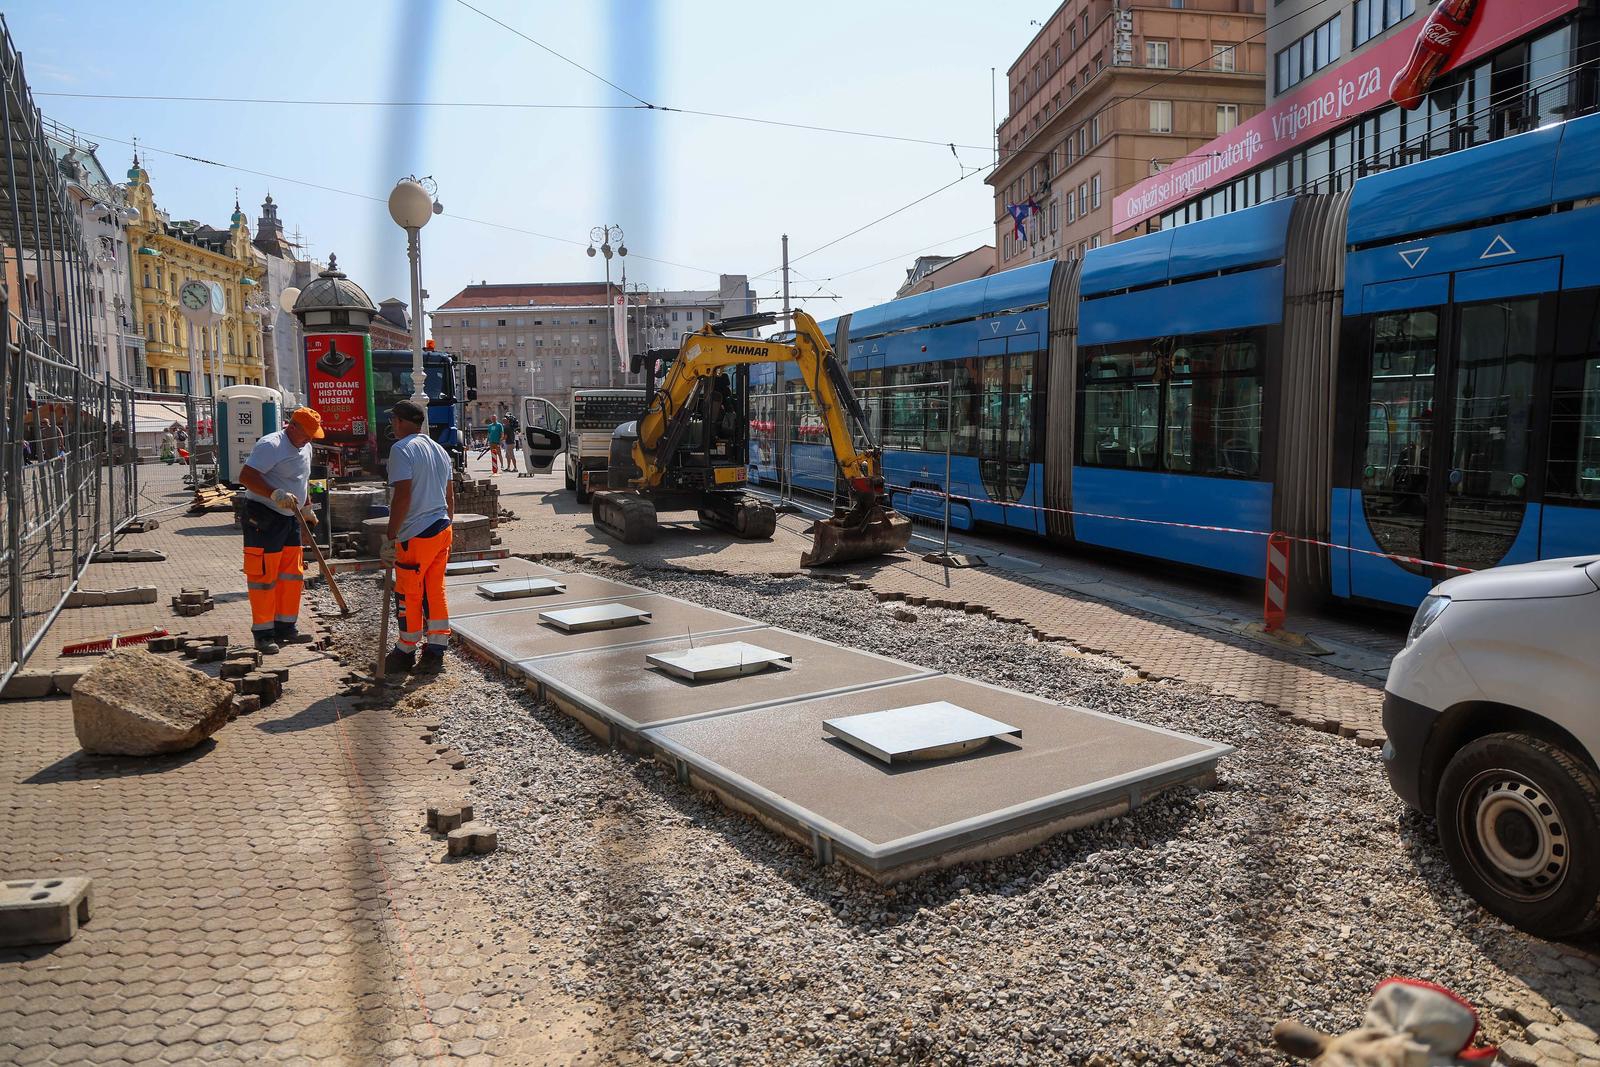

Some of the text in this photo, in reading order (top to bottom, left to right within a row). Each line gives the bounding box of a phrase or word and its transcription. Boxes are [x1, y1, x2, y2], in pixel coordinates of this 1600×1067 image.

[1127, 66, 1381, 218] Osvježi se i napuni baterije. Vrijeme je za
[726, 344, 769, 357] YANMAR
[312, 381, 360, 390] VIDEO GAME
[318, 389, 353, 397] HISTORY
[318, 397, 355, 405] MUSEUM
[322, 405, 352, 413] ZAGREB
